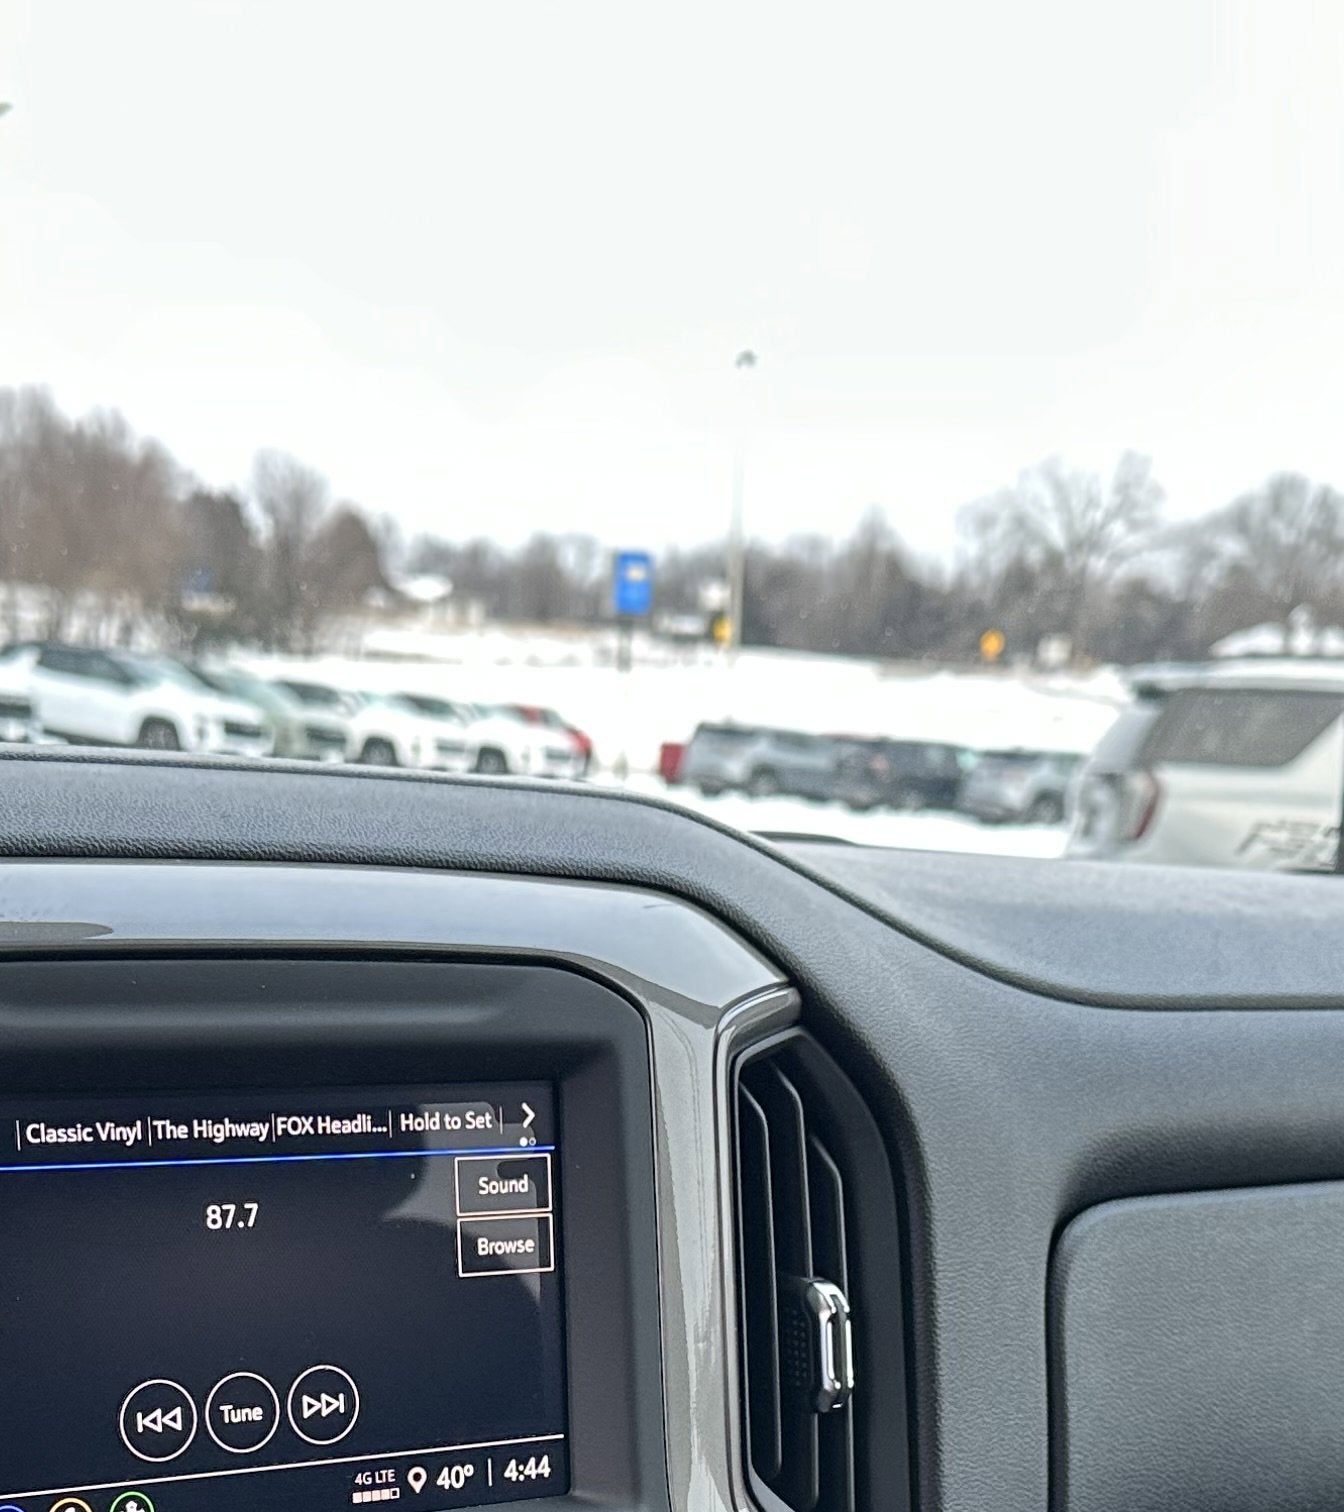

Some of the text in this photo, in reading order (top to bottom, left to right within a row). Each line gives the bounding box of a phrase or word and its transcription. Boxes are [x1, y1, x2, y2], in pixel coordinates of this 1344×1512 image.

[153, 1117, 270, 1144] The Highway
[276, 1116, 315, 1137] FOX
[400, 1111, 493, 1132] Hold to Set
[25, 1120, 142, 1147] Classic Vinyl
[478, 1174, 530, 1196] Sound
[205, 1203, 260, 1230] 87.7
[477, 1237, 536, 1257] Browse
[219, 1403, 264, 1425] Tune
[354, 1469, 396, 1486] 4G LTE
[503, 1454, 552, 1483] 4:44
